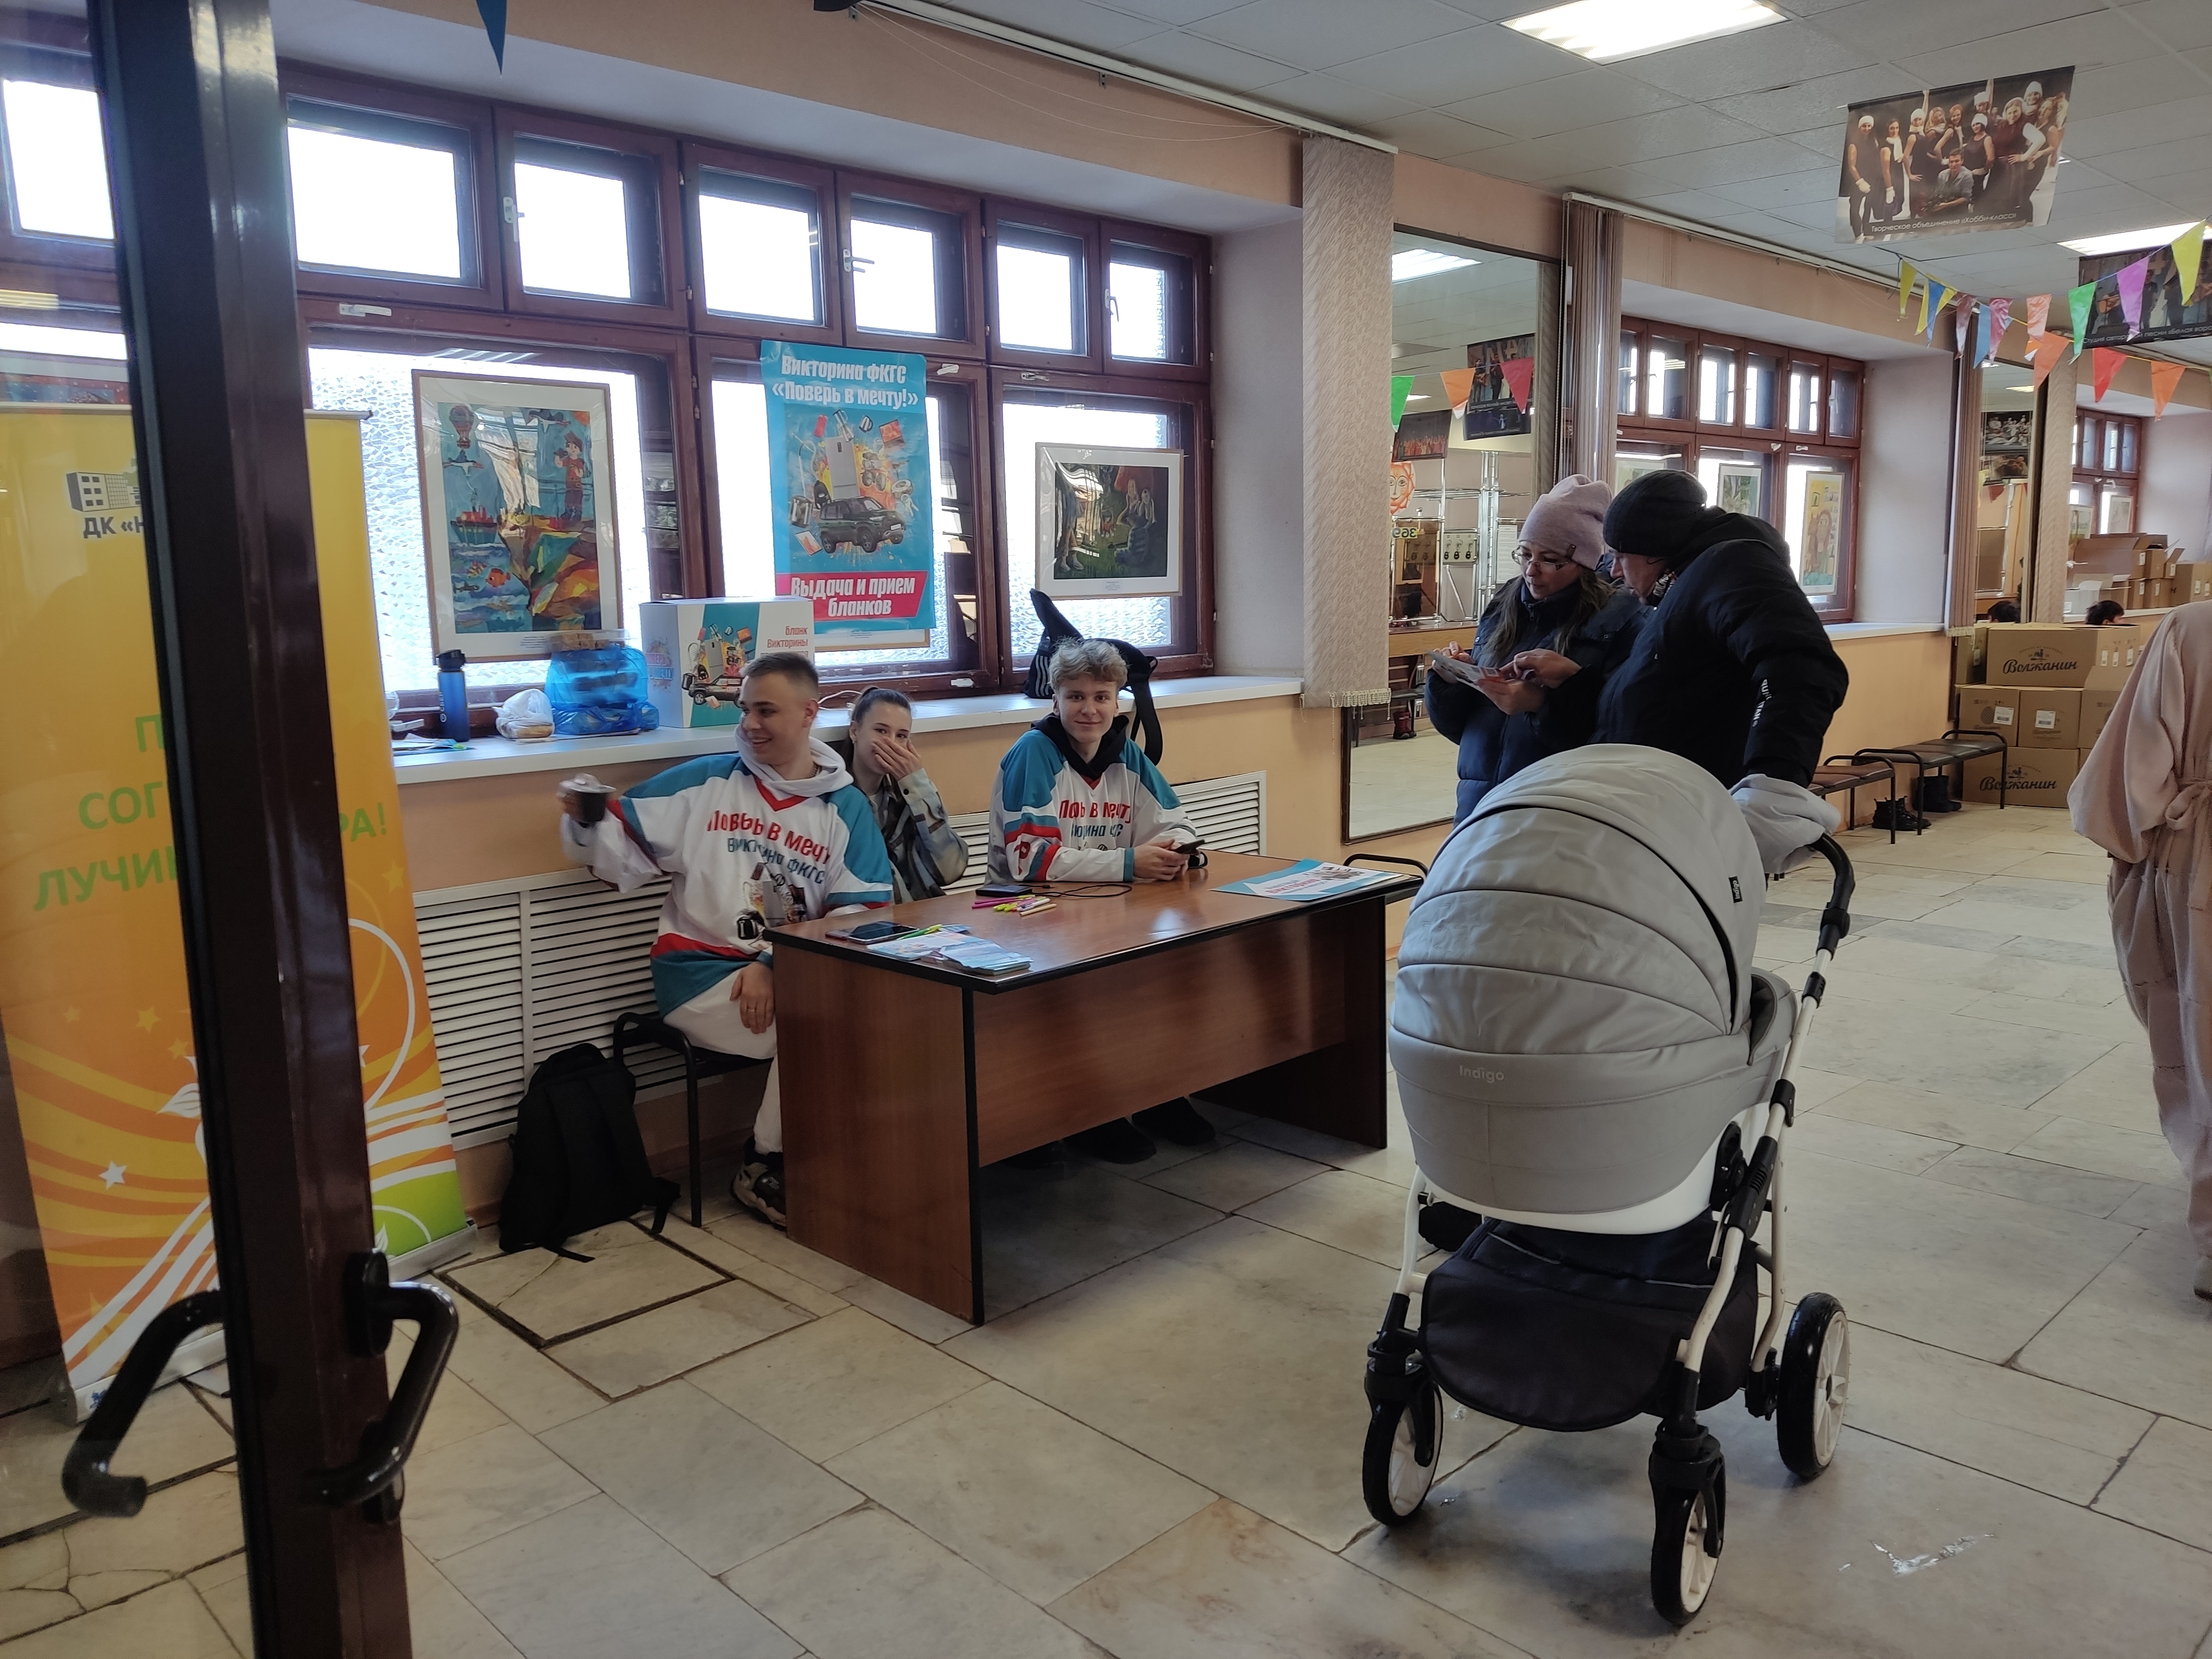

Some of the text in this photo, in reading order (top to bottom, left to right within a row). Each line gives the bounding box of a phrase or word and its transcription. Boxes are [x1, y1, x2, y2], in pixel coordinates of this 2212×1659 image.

[1871, 213, 2017, 233] Творческое объединение «Хобби-класс»
[781, 355, 906, 384] Викторина ФКГС
[772, 381, 841, 405] «Поверь
[858, 388, 919, 410] мечту!»
[84, 517, 117, 539] ДК
[791, 577, 916, 600] Выдача и прием
[828, 598, 892, 617] бланков
[785, 625, 808, 635] бланк
[767, 639, 808, 649] Викторины
[2003, 659, 2078, 674] Волжанин
[79, 781, 164, 830] СОГ
[33, 845, 178, 912] ЛУЧИ
[787, 858, 825, 884] ФКГС
[1733, 880, 1741, 899] Indigo
[1459, 1065, 1504, 1083] Indigo
